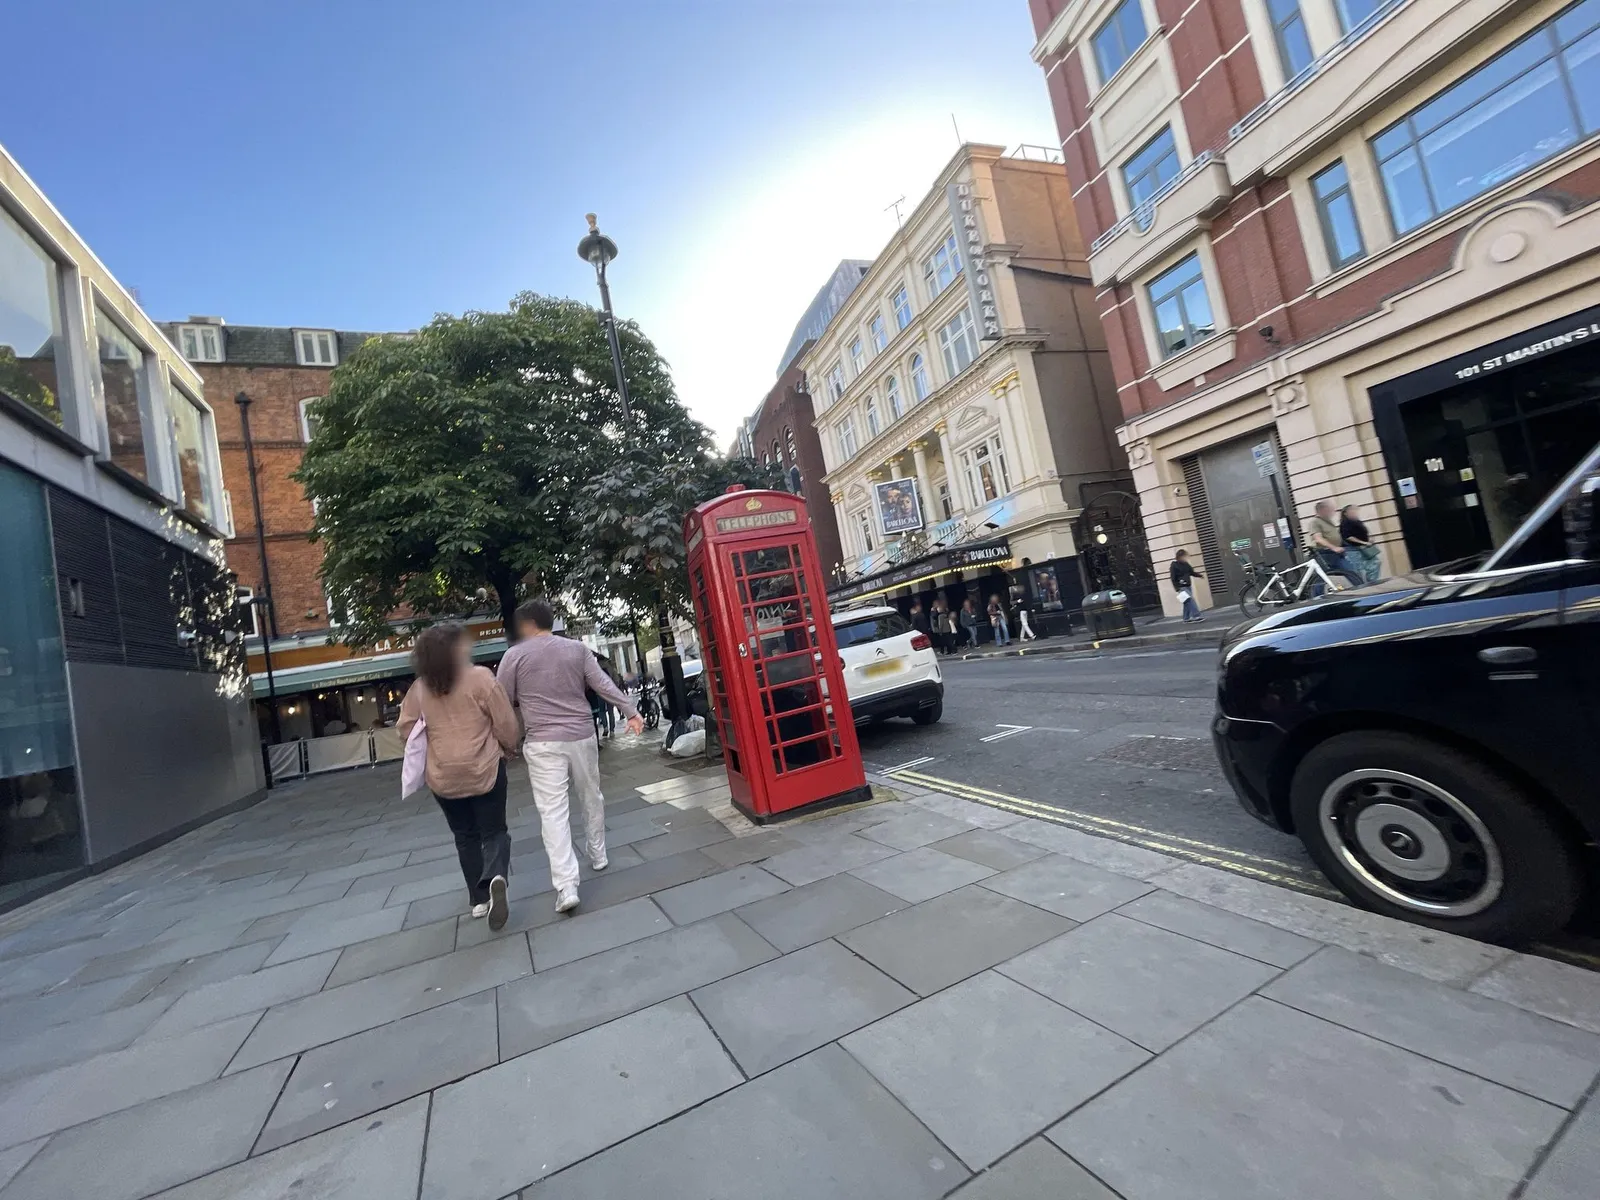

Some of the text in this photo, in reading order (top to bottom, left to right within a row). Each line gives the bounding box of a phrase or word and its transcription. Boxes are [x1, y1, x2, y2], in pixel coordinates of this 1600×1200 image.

[1455, 365, 1480, 379] 101
[1482, 356, 1503, 370] ST
[1505, 327, 1589, 363] MARTIN'S
[1424, 457, 1444, 472] 101
[719, 511, 793, 530] TELEPHONE
[375, 638, 391, 652] LA
